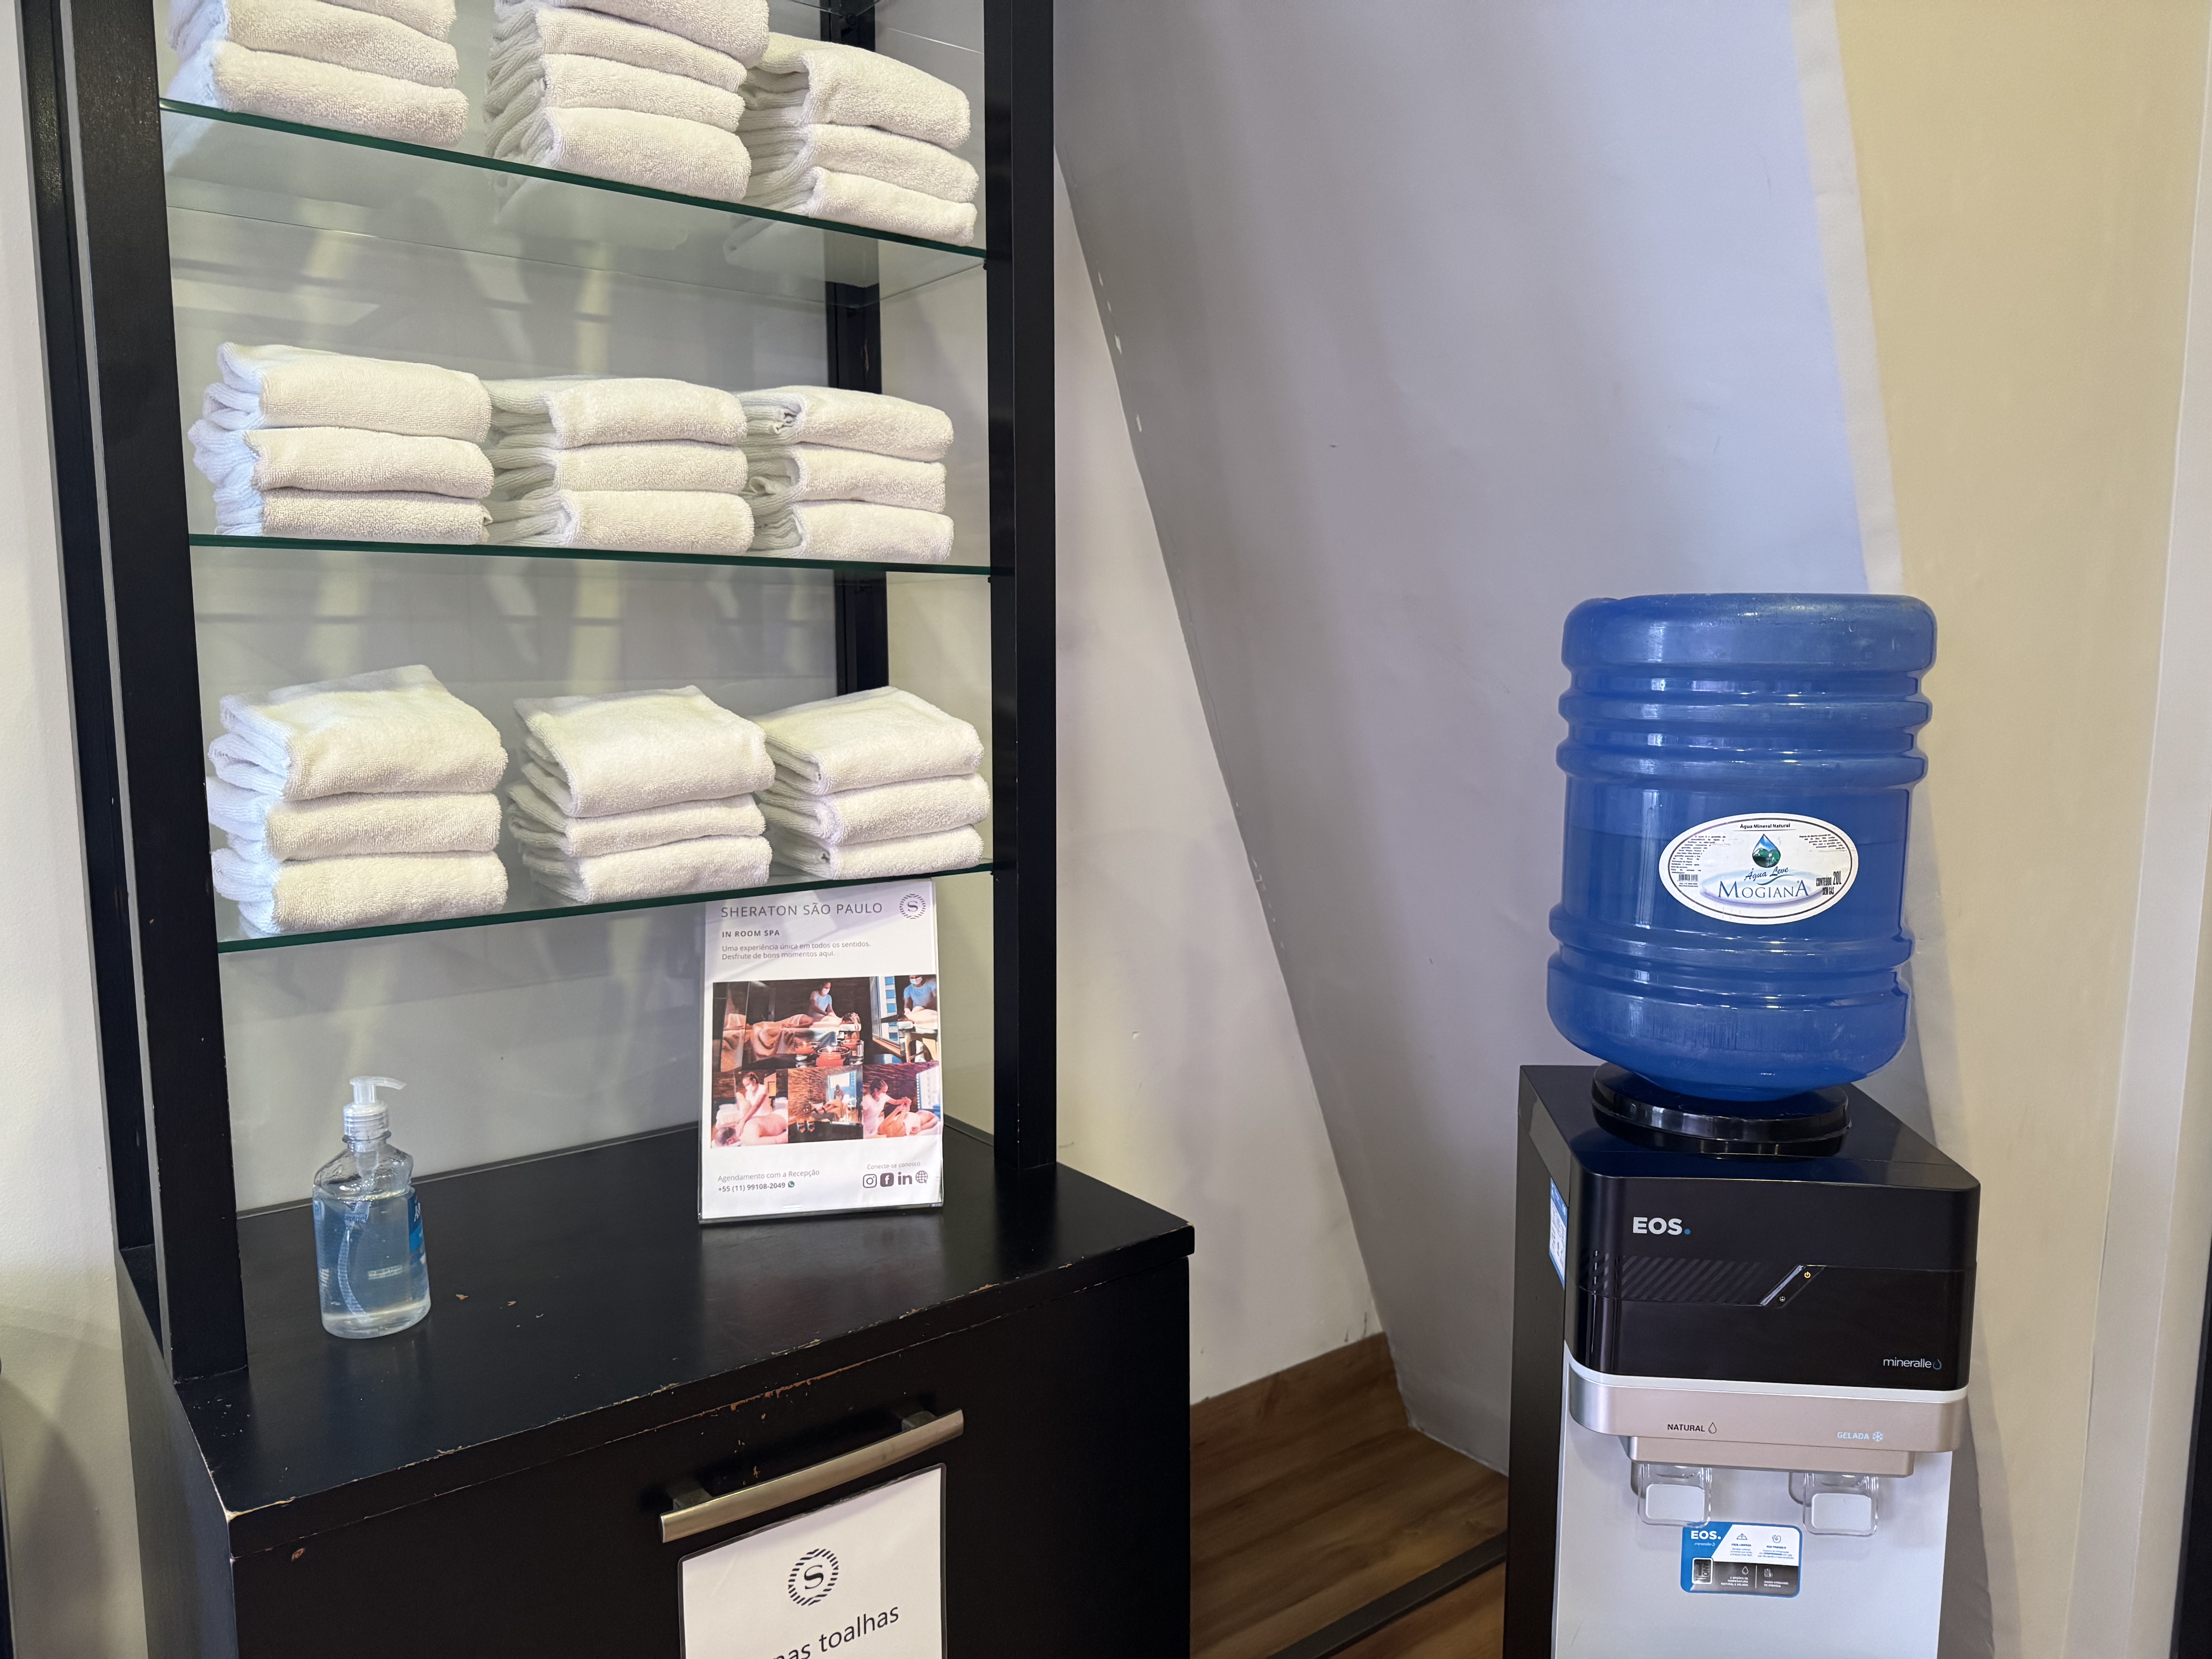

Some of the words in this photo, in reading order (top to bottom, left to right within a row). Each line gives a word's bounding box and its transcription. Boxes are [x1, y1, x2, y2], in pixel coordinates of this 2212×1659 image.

[1744, 867, 1768, 882] Água
[1769, 866, 1789, 877] Leve
[1833, 871, 1842, 885] 20L
[721, 904, 798, 918] SHERATON
[803, 902, 831, 915] SÃO
[836, 902, 883, 914] PAULO
[740, 943, 778, 953] experiência
[819, 950, 835, 958] aqui.
[717, 1172, 766, 1183] Agendamento
[788, 1169, 820, 1179] Recepção
[718, 1184, 730, 1192] +55
[732, 1183, 745, 1193] (11)
[746, 1181, 786, 1190] 99108-2049
[1883, 1357, 1932, 1368] mineralle
[1667, 1424, 1705, 1432] NATURAL
[1837, 1431, 1869, 1440] GELADA
[819, 1606, 899, 1652] toalhas
